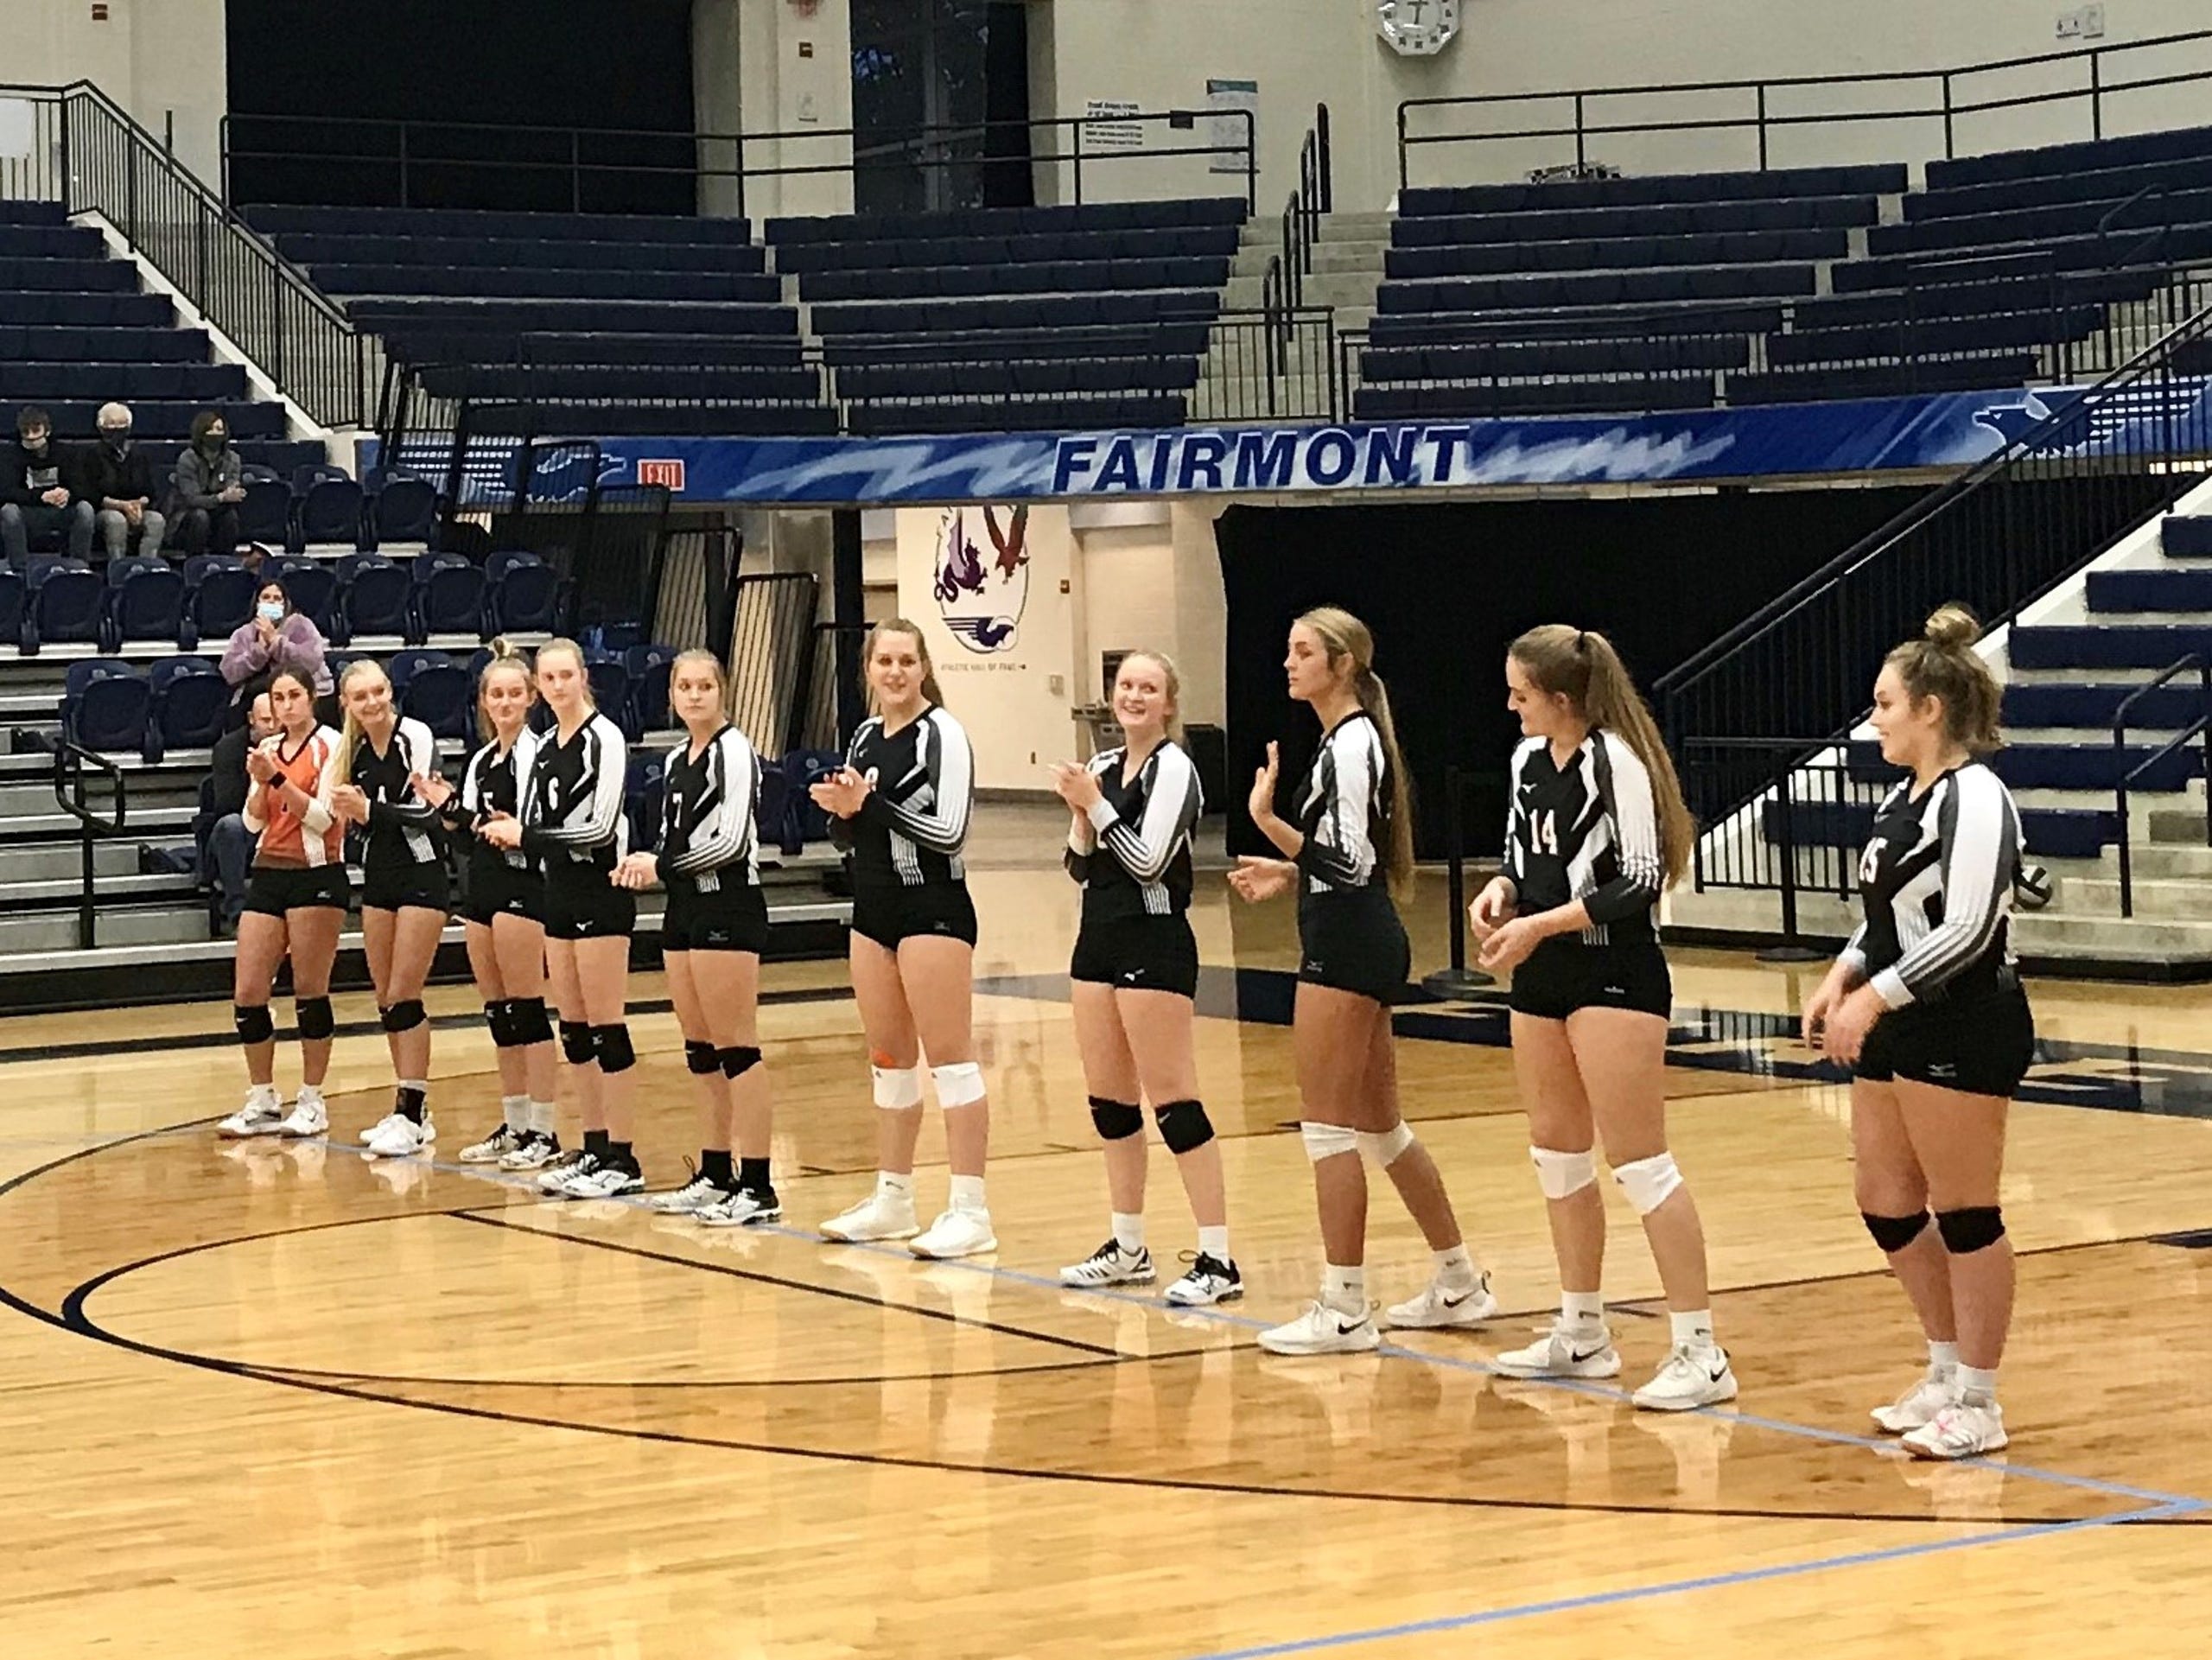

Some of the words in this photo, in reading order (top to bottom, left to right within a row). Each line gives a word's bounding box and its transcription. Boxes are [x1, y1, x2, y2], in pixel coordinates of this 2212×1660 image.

[646, 463, 677, 487] EXIT
[1052, 424, 1470, 493] FAIRMONT
[548, 776, 559, 811] 6
[672, 792, 683, 829] 7
[1529, 808, 1558, 855] 14
[1859, 836, 1889, 884] 15
